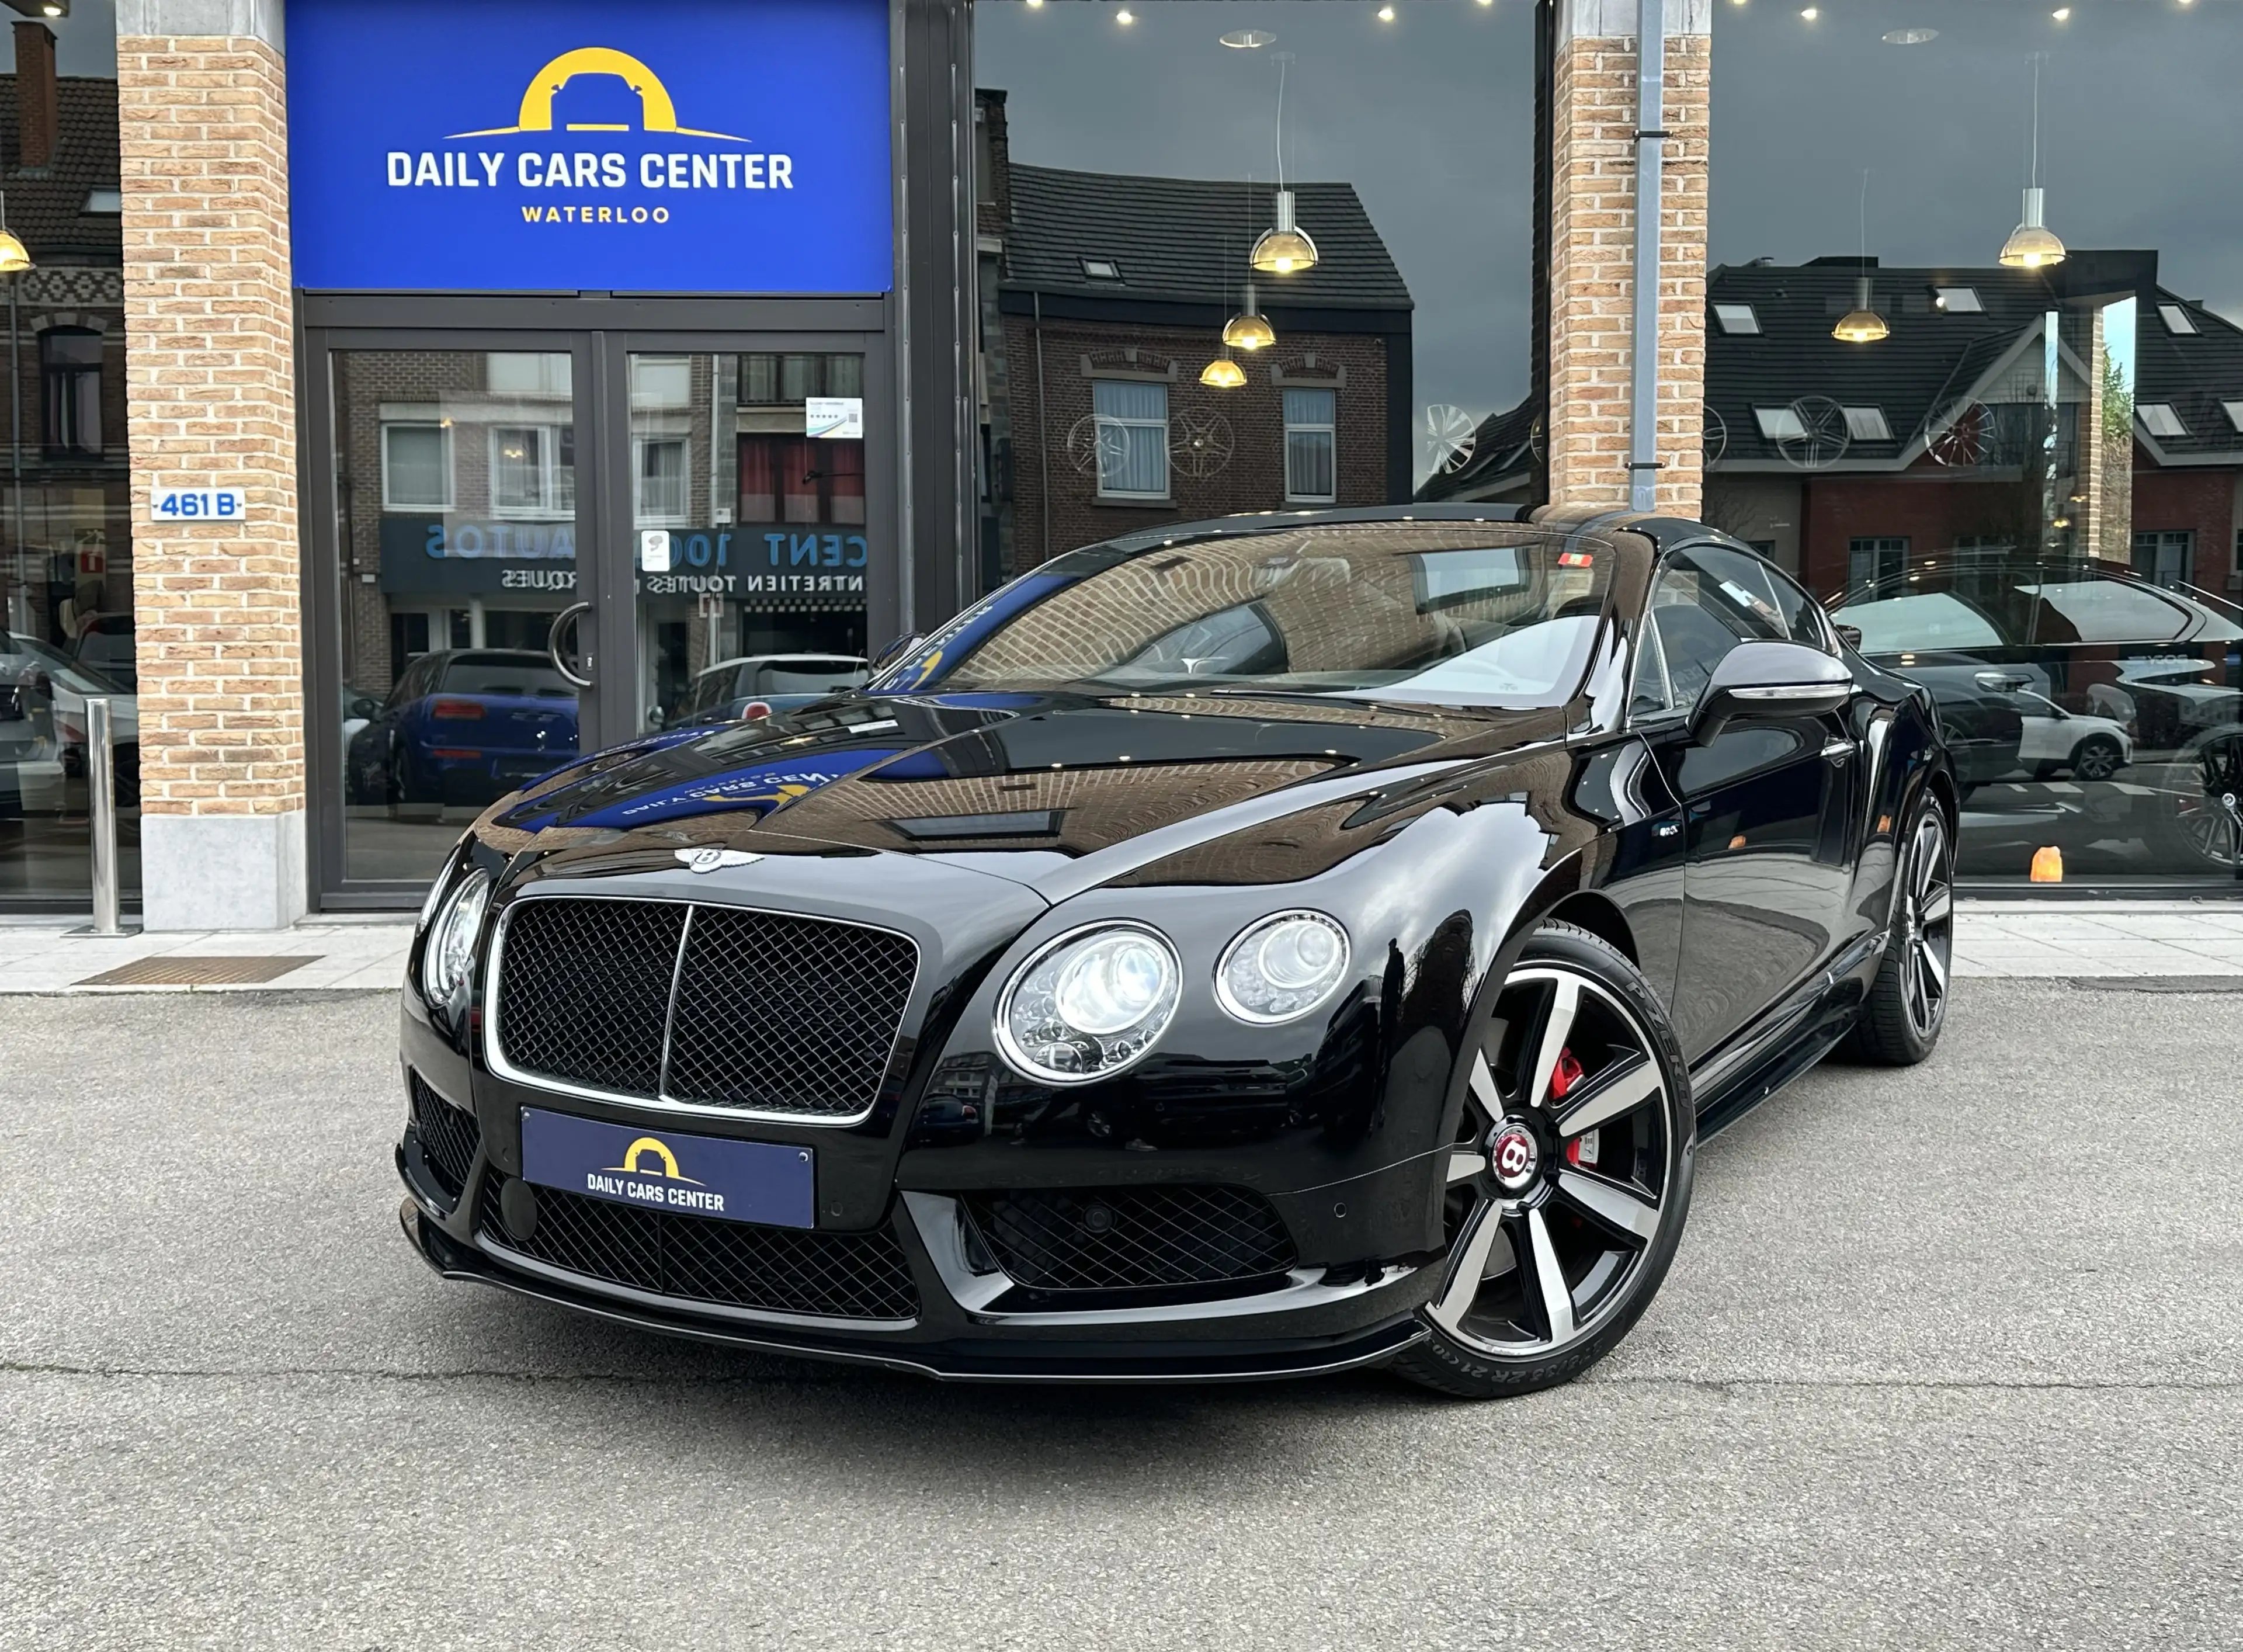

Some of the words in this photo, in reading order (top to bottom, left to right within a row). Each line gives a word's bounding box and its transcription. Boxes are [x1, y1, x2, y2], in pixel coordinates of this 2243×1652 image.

[387, 151, 505, 187] DAILY
[518, 152, 626, 188] CARS
[640, 153, 794, 189] CENTER
[522, 206, 671, 224] WATERLOO
[160, 493, 209, 516] 461
[216, 493, 235, 516] B
[1625, 981, 1646, 999] P
[587, 1173, 624, 1195] DAILY
[627, 1182, 664, 1202] CARS
[668, 1188, 724, 1212] CENTER
